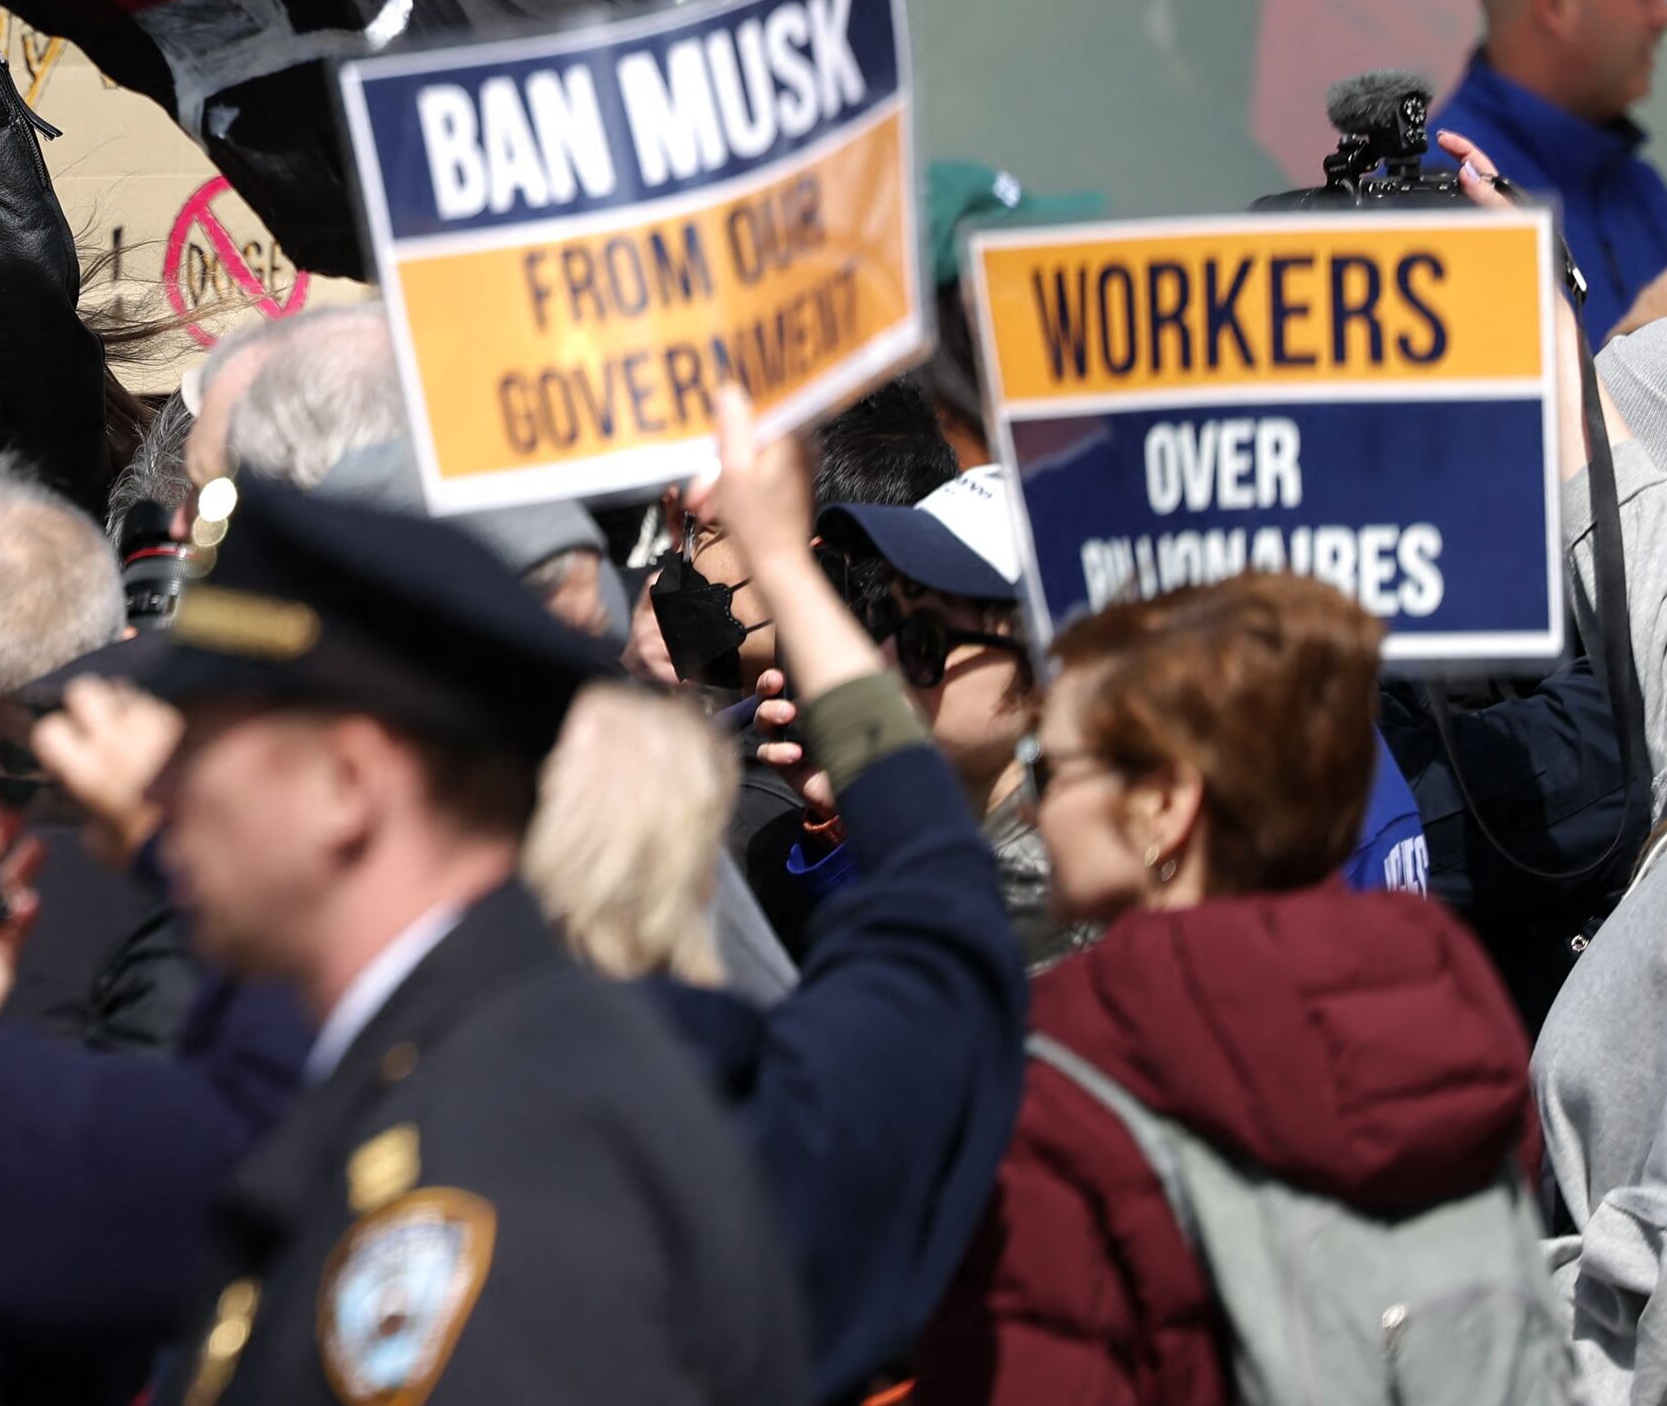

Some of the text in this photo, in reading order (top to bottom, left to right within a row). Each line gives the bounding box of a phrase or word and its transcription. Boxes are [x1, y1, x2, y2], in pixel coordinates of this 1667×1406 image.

[415, 60, 617, 223] BAN
[522, 175, 828, 334] FROM OUR
[1029, 250, 1452, 384] WORKERS
[496, 256, 858, 457] GOVERNMENT
[1142, 415, 1304, 516] OVER
